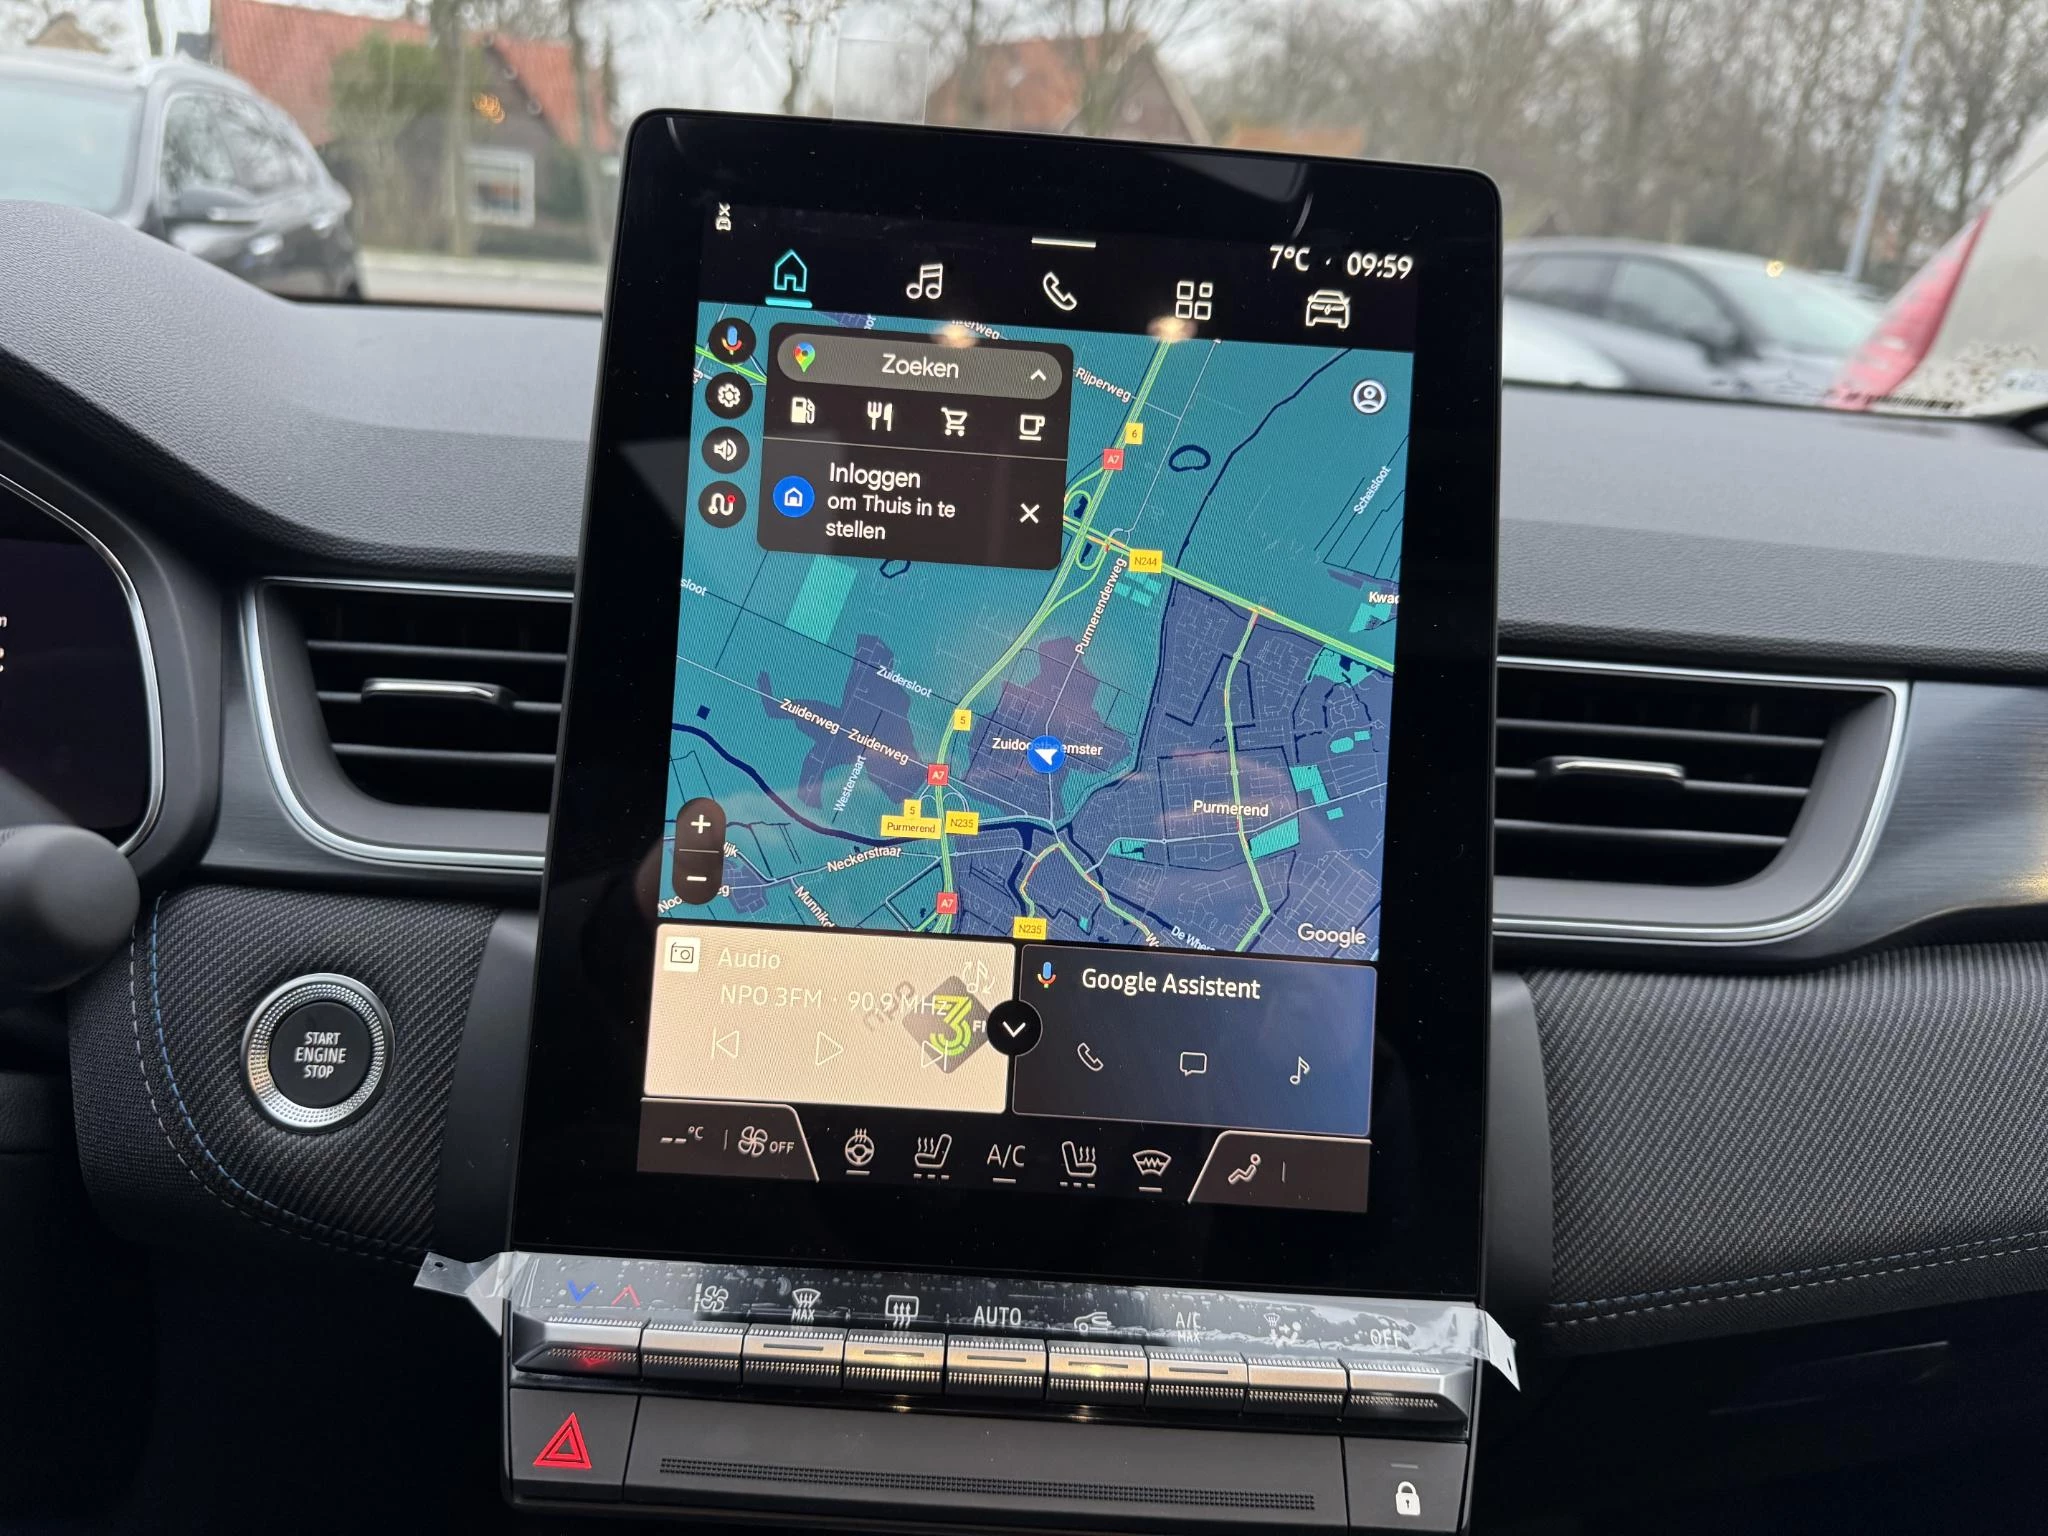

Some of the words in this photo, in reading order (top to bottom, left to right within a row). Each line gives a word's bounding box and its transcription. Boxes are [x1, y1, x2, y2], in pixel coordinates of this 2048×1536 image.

[1347, 251, 1413, 279] 09:59
[881, 353, 960, 379] Zoeken
[1075, 366, 1132, 403] Rijperweg
[1107, 454, 1120, 465] A7
[829, 462, 921, 491] Inloggen
[827, 496, 856, 511] om
[862, 494, 911, 515] Thuis
[917, 498, 932, 516] in
[938, 501, 956, 518] te
[825, 520, 886, 540] stellen
[1134, 555, 1158, 566] N244
[1074, 556, 1128, 655] Purmerenderweg
[876, 664, 933, 698] Zuidersloot
[779, 697, 841, 736] Zuiderweg
[847, 727, 910, 766] Zuiderweg
[833, 754, 867, 813] Westervaart
[931, 770, 945, 781] A7
[1193, 799, 1270, 818] Purmerend
[886, 821, 937, 835] Purmerend
[950, 817, 975, 829] N235
[826, 846, 902, 873] Neckerstraat
[941, 898, 954, 908] A7
[1018, 923, 1042, 936] N235
[1171, 925, 1186, 940] De
[1297, 922, 1367, 949] Google
[717, 946, 782, 971] Audio
[1082, 968, 1156, 996] Google
[1162, 973, 1261, 1000] Assistent
[720, 983, 769, 1006] NPO
[775, 986, 822, 1008] 3FM
[901, 994, 948, 1016] MHz
[304, 1031, 341, 1046] START
[294, 1047, 347, 1063] ENGINE
[303, 1065, 334, 1079] STOP
[769, 1140, 795, 1154] OFF
[987, 1144, 1025, 1168] A/C
[791, 1307, 815, 1322] MAX
[974, 1305, 1022, 1327] AUTO
[1175, 1311, 1201, 1329] A/C
[1370, 1328, 1402, 1348] OFF
